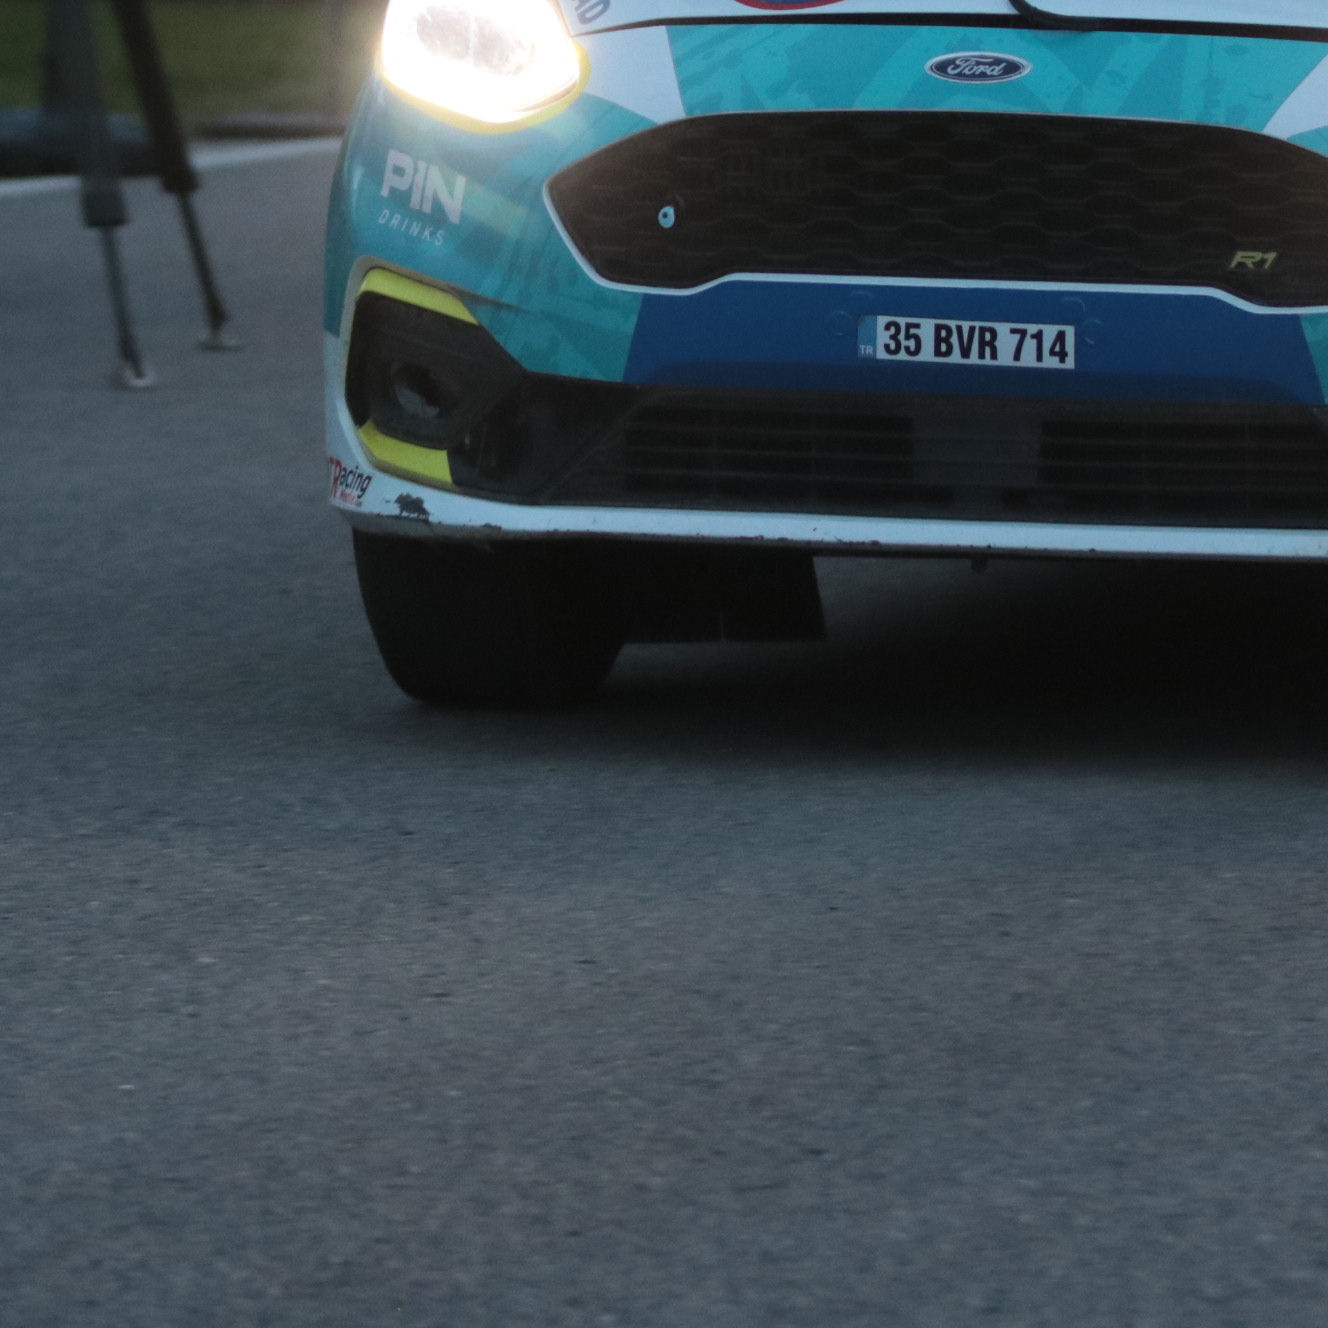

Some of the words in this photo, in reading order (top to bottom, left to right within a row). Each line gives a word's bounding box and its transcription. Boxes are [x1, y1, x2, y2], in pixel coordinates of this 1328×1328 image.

[946, 57, 1007, 76] Ford
[380, 149, 467, 224] PIN
[377, 210, 446, 247] DRINKS
[859, 344, 874, 356] TR
[883, 320, 922, 357] 35
[933, 323, 999, 361] BVR
[1009, 327, 1069, 364] 714
